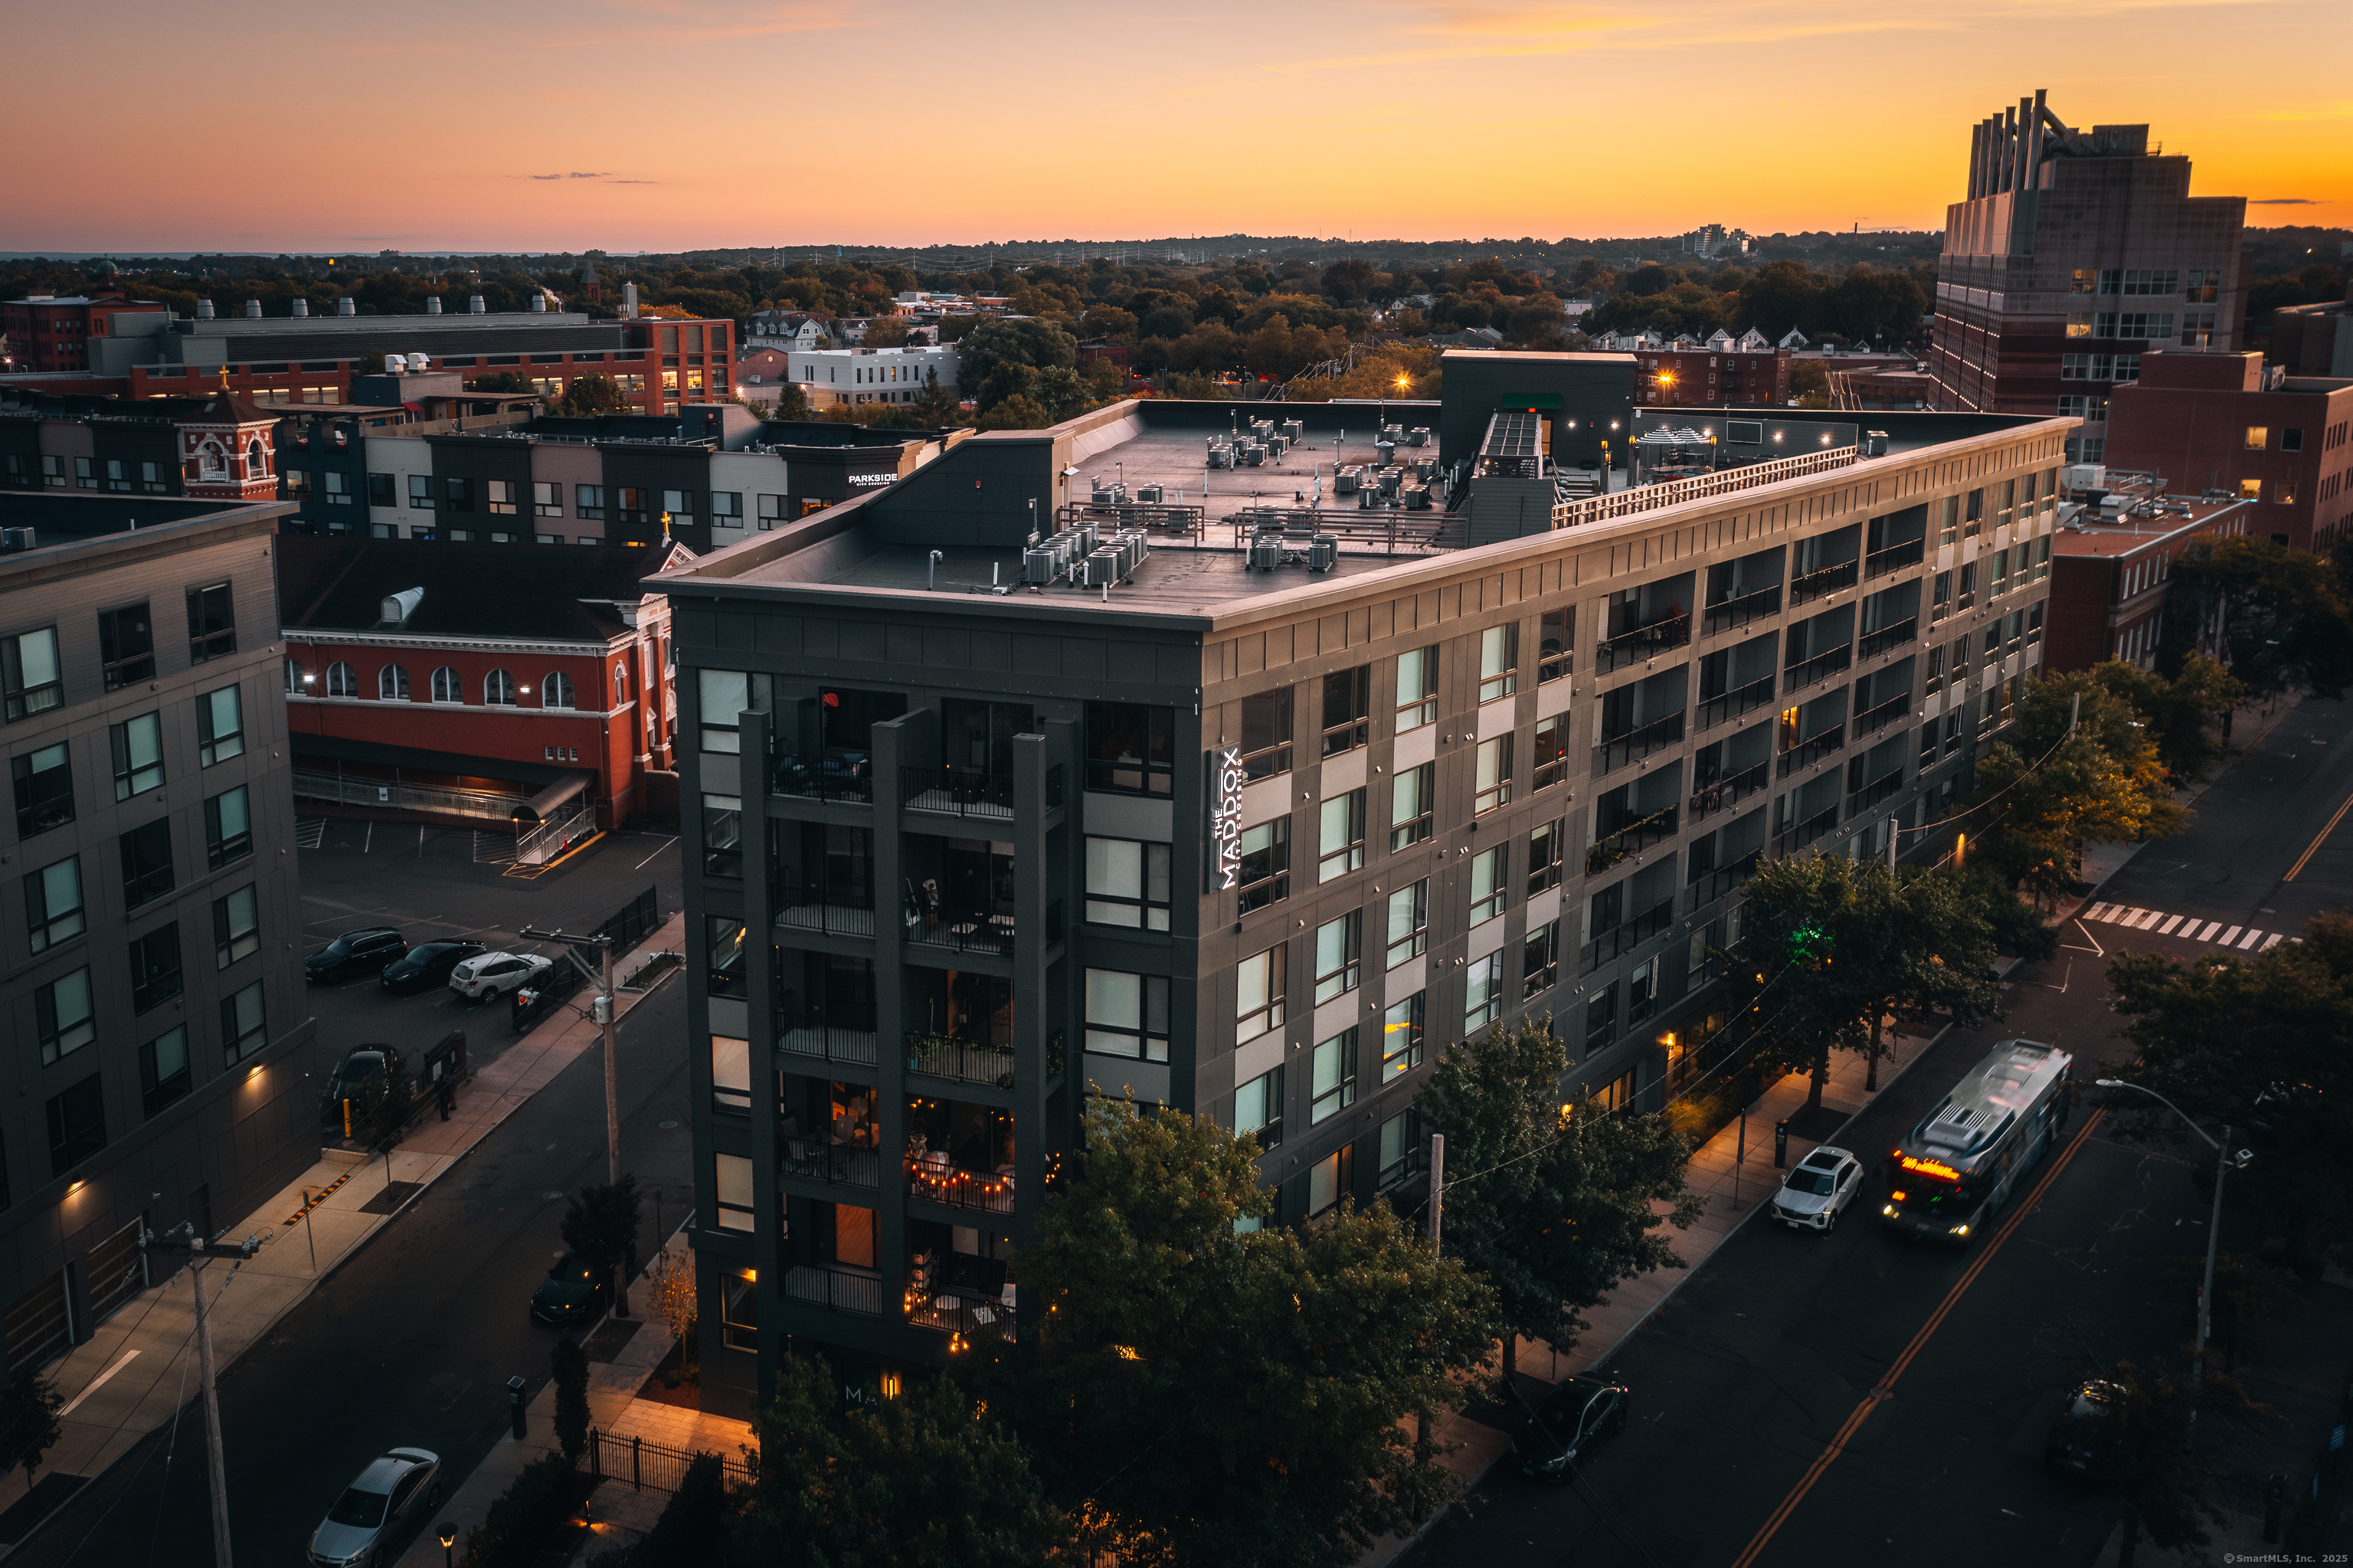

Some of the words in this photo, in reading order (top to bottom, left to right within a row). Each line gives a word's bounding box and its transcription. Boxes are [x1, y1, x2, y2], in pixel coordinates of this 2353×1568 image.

[848, 473, 898, 483] PARKSIDE
[1215, 808, 1223, 839] THE
[1222, 747, 1238, 889] MADDOX
